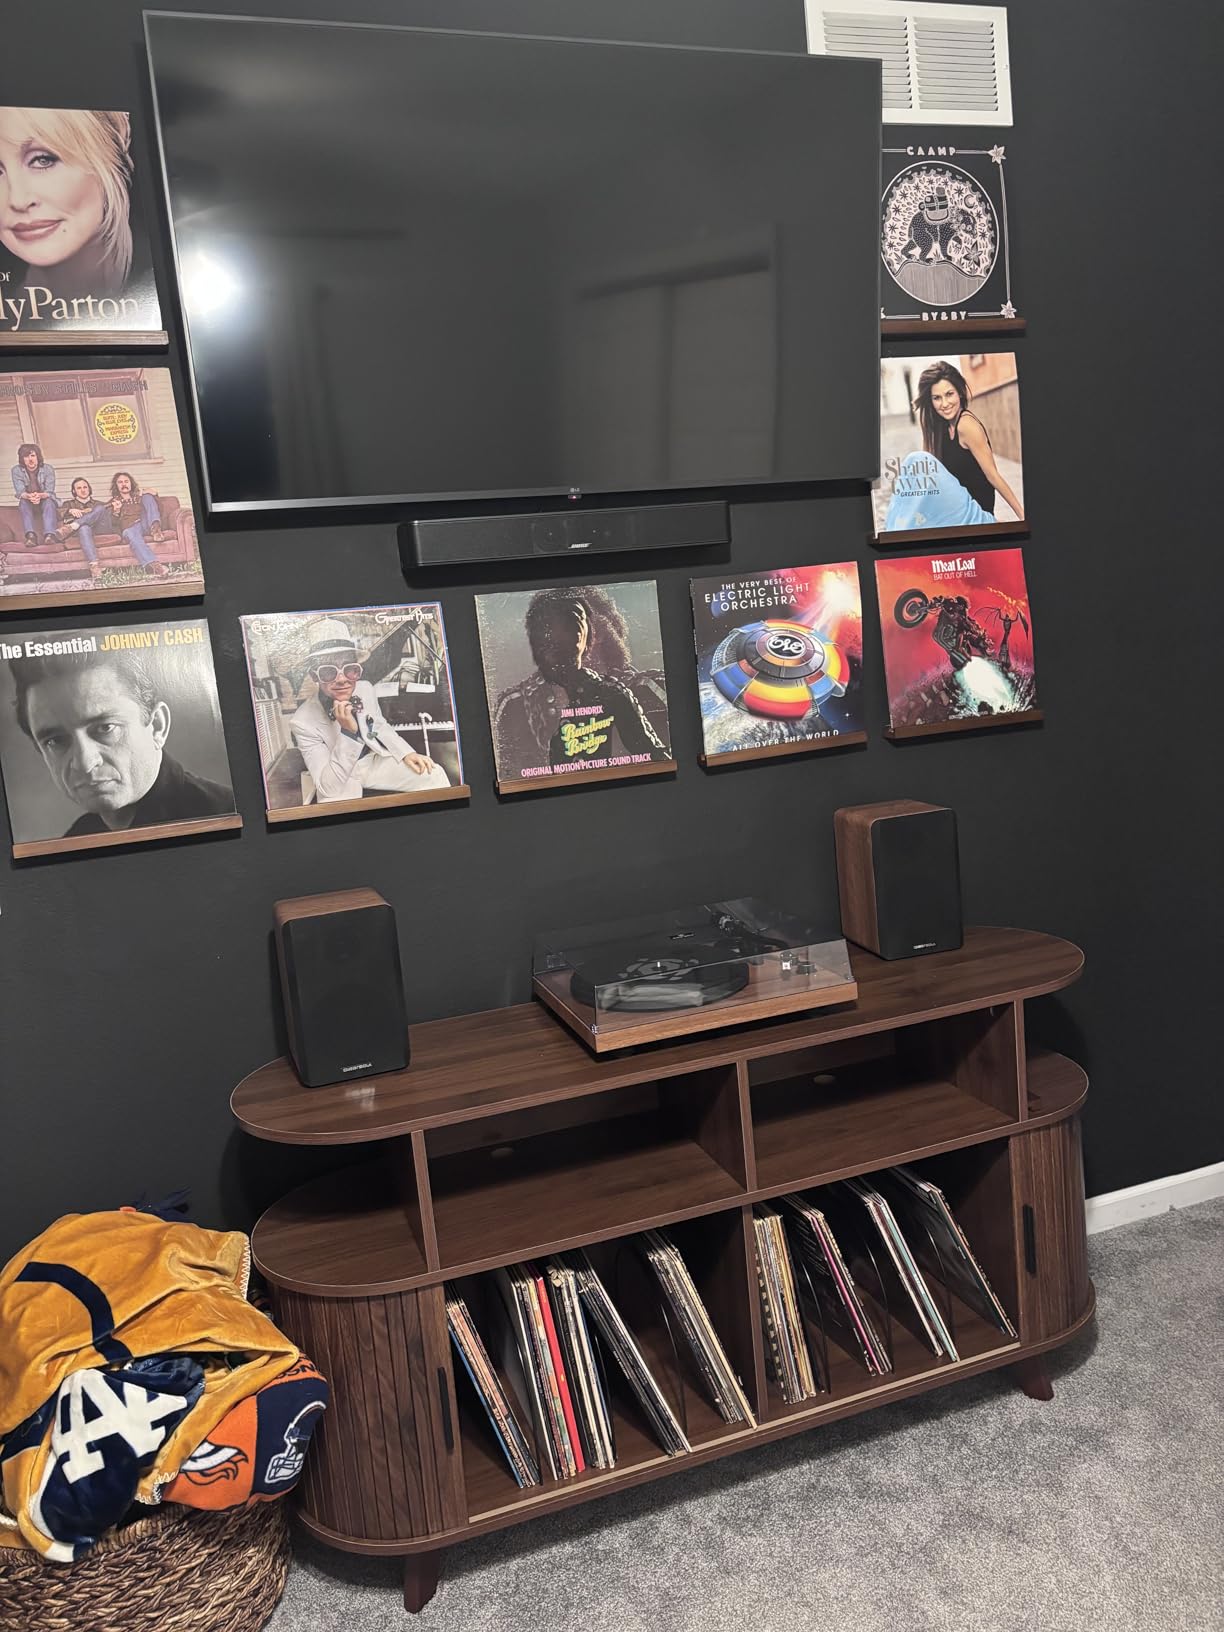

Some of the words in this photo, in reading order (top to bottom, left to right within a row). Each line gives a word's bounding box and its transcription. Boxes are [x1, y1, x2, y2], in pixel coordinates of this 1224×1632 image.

[906, 146, 956, 156] CAAMP
[900, 490, 927, 498] GREATEST
[933, 573, 943, 581] BAT
[943, 571, 955, 580] OUT
[955, 571, 963, 579] OF
[963, 570, 978, 578] HELL
[721, 582, 736, 590] THE
[739, 580, 761, 589] VERY
[764, 577, 782, 586] BEST
[704, 587, 767, 603] ELECTRIC
[773, 582, 809, 596] LIGHT
[720, 594, 797, 612] ORCHESTRA
[0, 643, 22, 660] he
[24, 636, 98, 658] Essential
[100, 631, 160, 651] JOHNNY
[164, 627, 204, 646] CASH
[561, 708, 574, 718] JIMI
[574, 705, 604, 717] HENDRIX
[521, 766, 553, 777] ORIGINAL
[553, 762, 581, 774] MOTION
[581, 758, 608, 770] PICTURE
[608, 755, 631, 767] SOUND
[631, 752, 652, 763] TRACK
